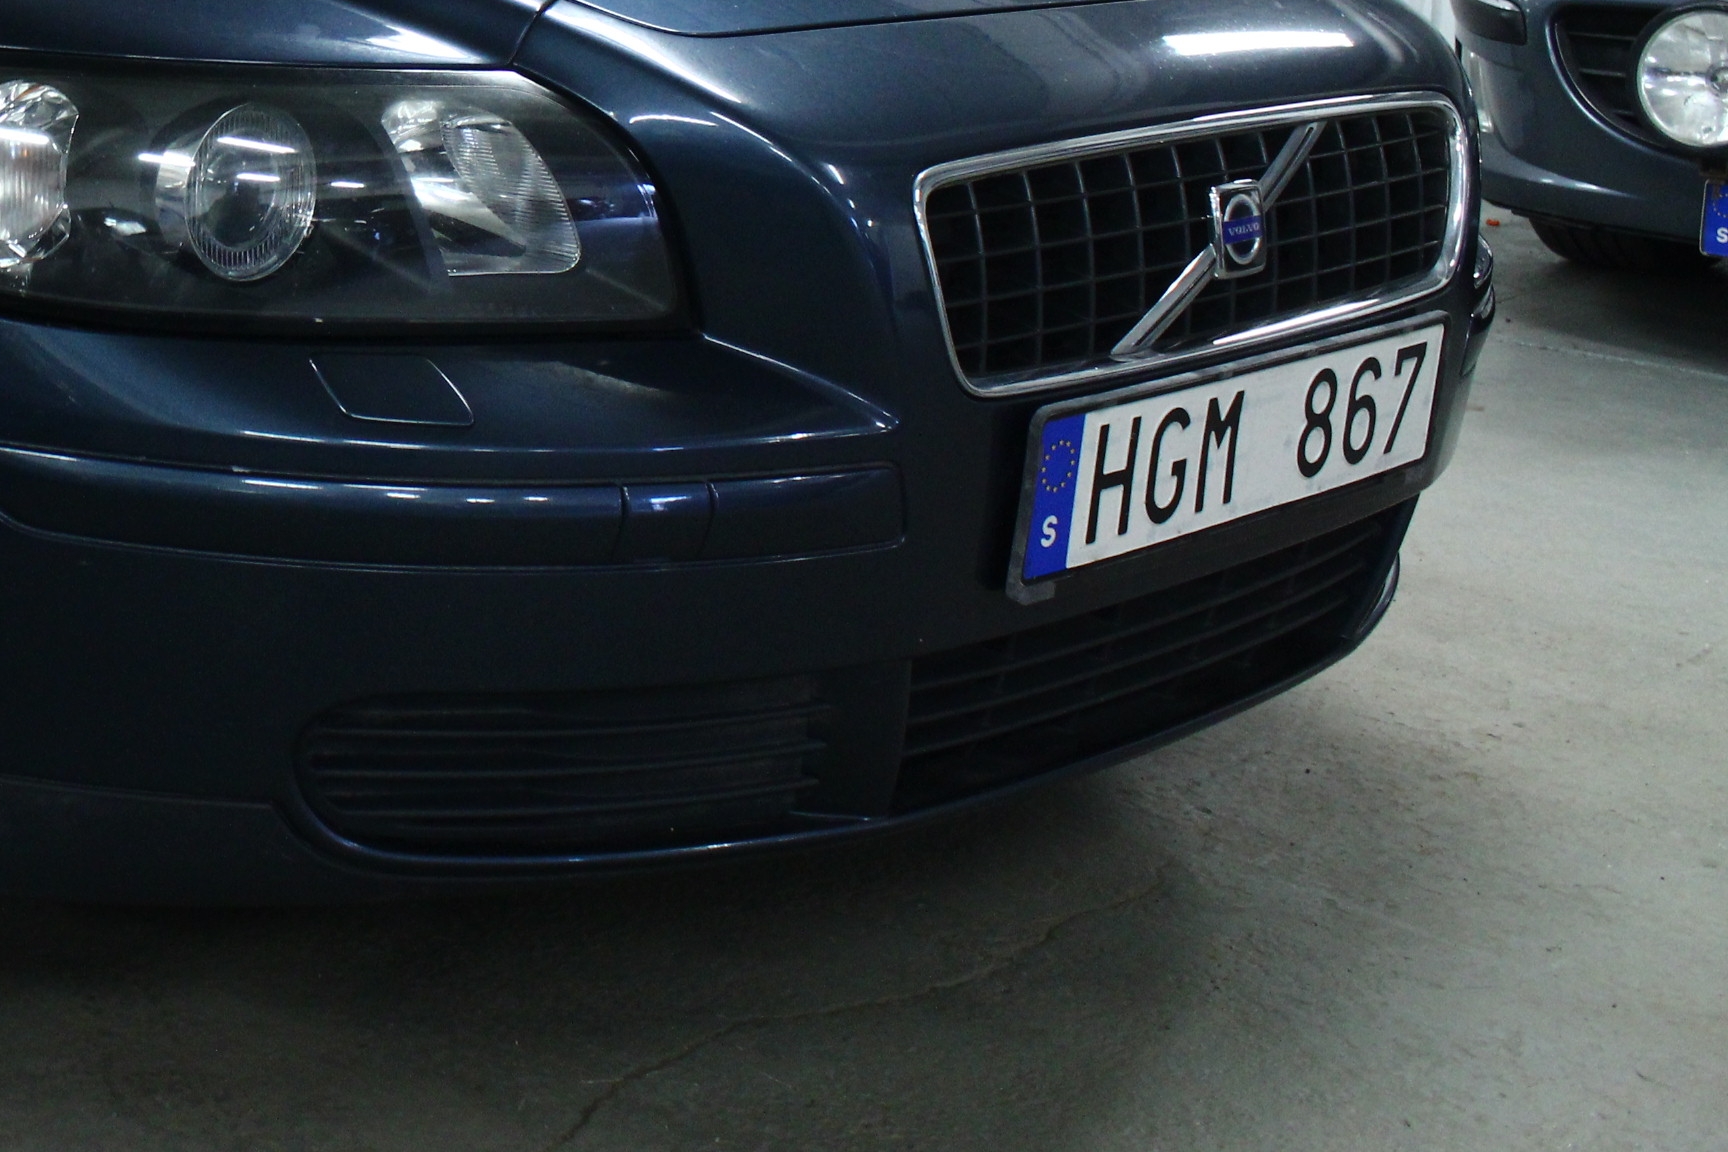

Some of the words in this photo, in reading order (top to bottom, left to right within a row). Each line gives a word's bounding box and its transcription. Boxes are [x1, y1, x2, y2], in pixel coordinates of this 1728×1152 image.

[1228, 222, 1260, 237] VOLVO
[1716, 226, 1728, 244] S
[1040, 514, 1059, 548] S
[1085, 390, 1246, 545] HGM
[1296, 341, 1428, 479] 867
